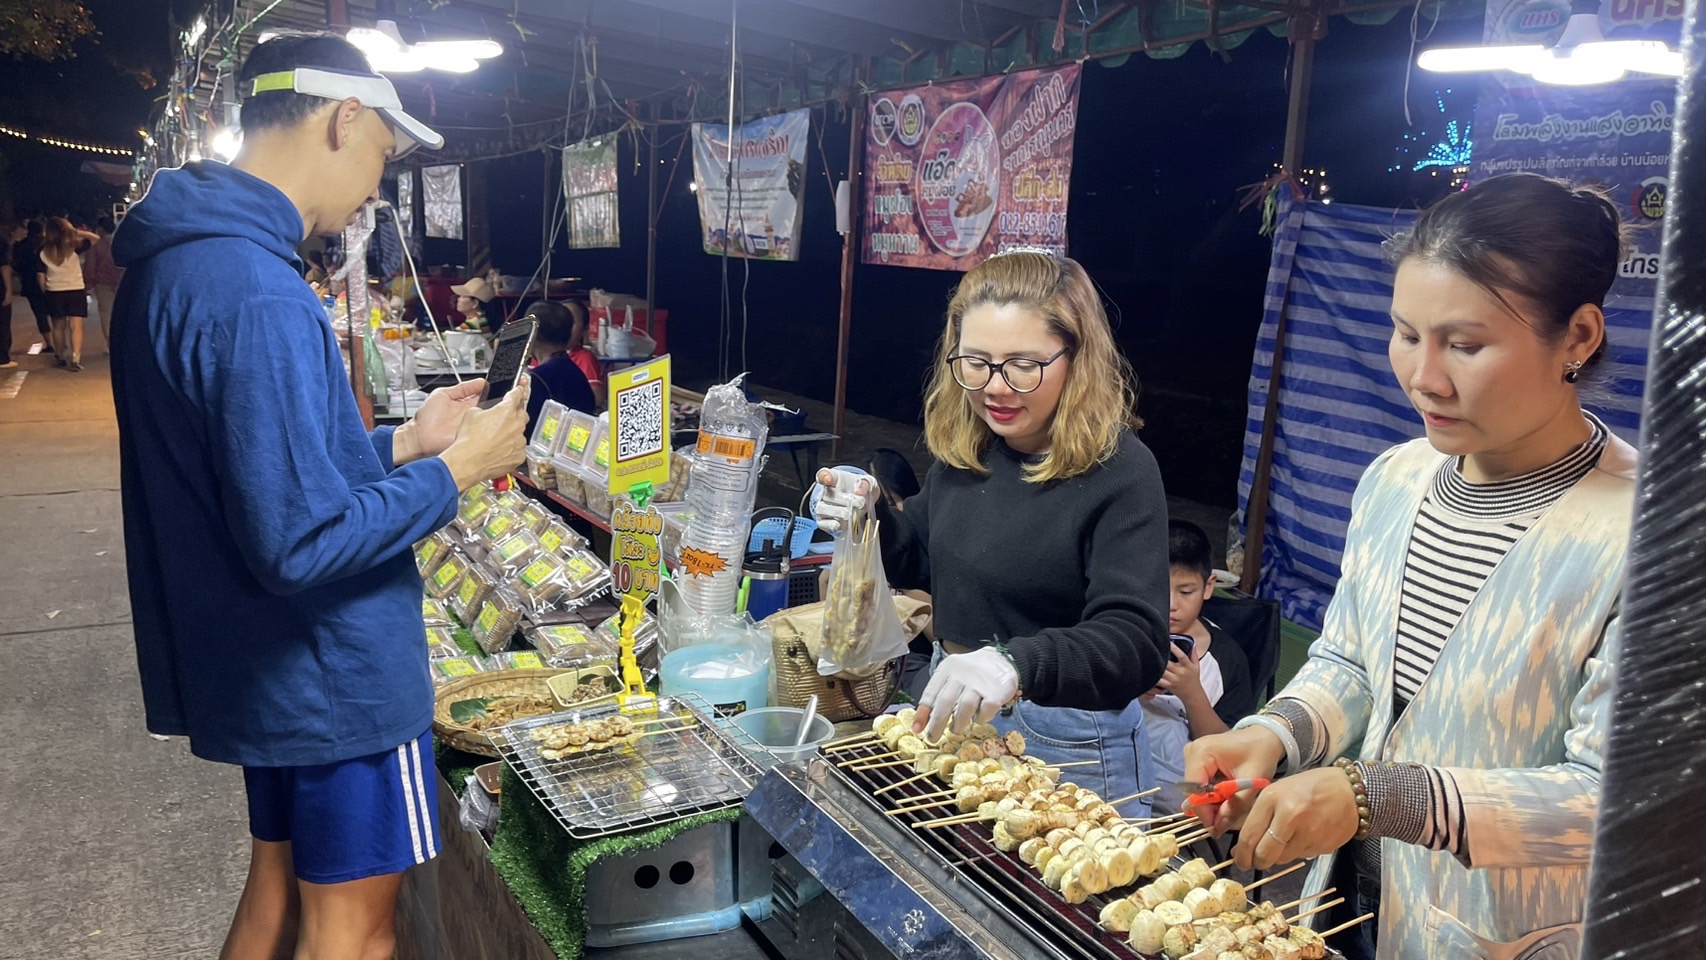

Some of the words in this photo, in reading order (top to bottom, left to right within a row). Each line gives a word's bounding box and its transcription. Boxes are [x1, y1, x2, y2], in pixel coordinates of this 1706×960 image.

[1002, 73, 1066, 149] ของฝาก
[620, 535, 644, 559] ไม้ละ
[613, 561, 631, 592] 10
[634, 566, 658, 593] บาท
